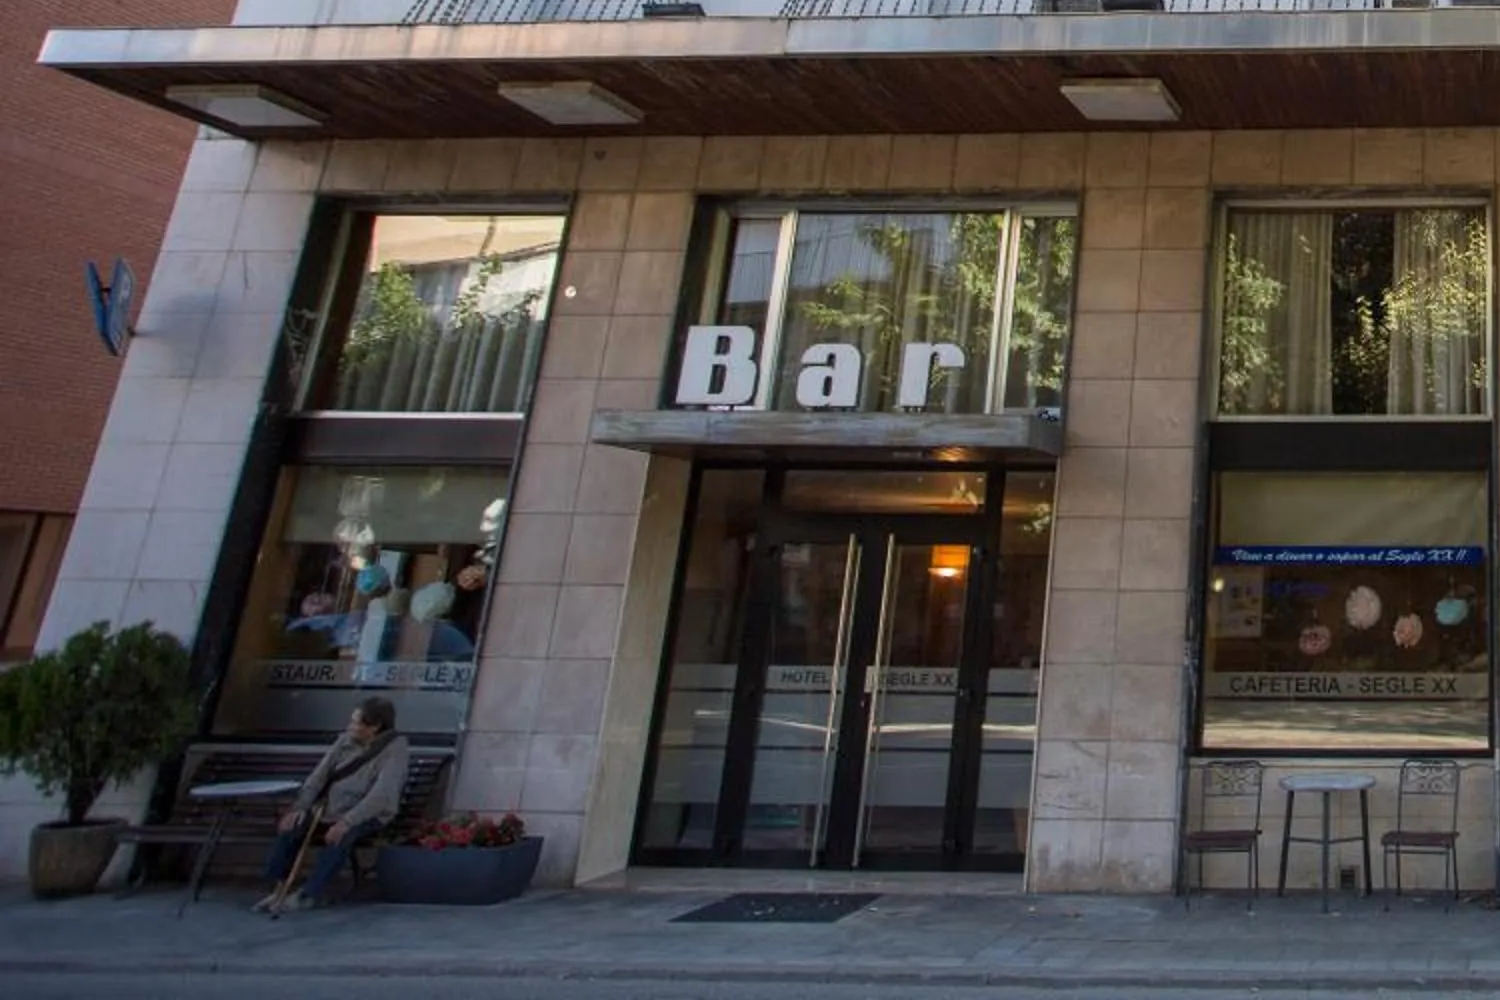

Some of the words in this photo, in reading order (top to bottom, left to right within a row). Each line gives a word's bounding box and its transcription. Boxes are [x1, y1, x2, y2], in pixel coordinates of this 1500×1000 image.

[674, 324, 966, 408] Bar
[782, 671, 829, 685] HOTEL
[1358, 676, 1425, 694] SEGLE
[1432, 676, 1458, 694] XX
